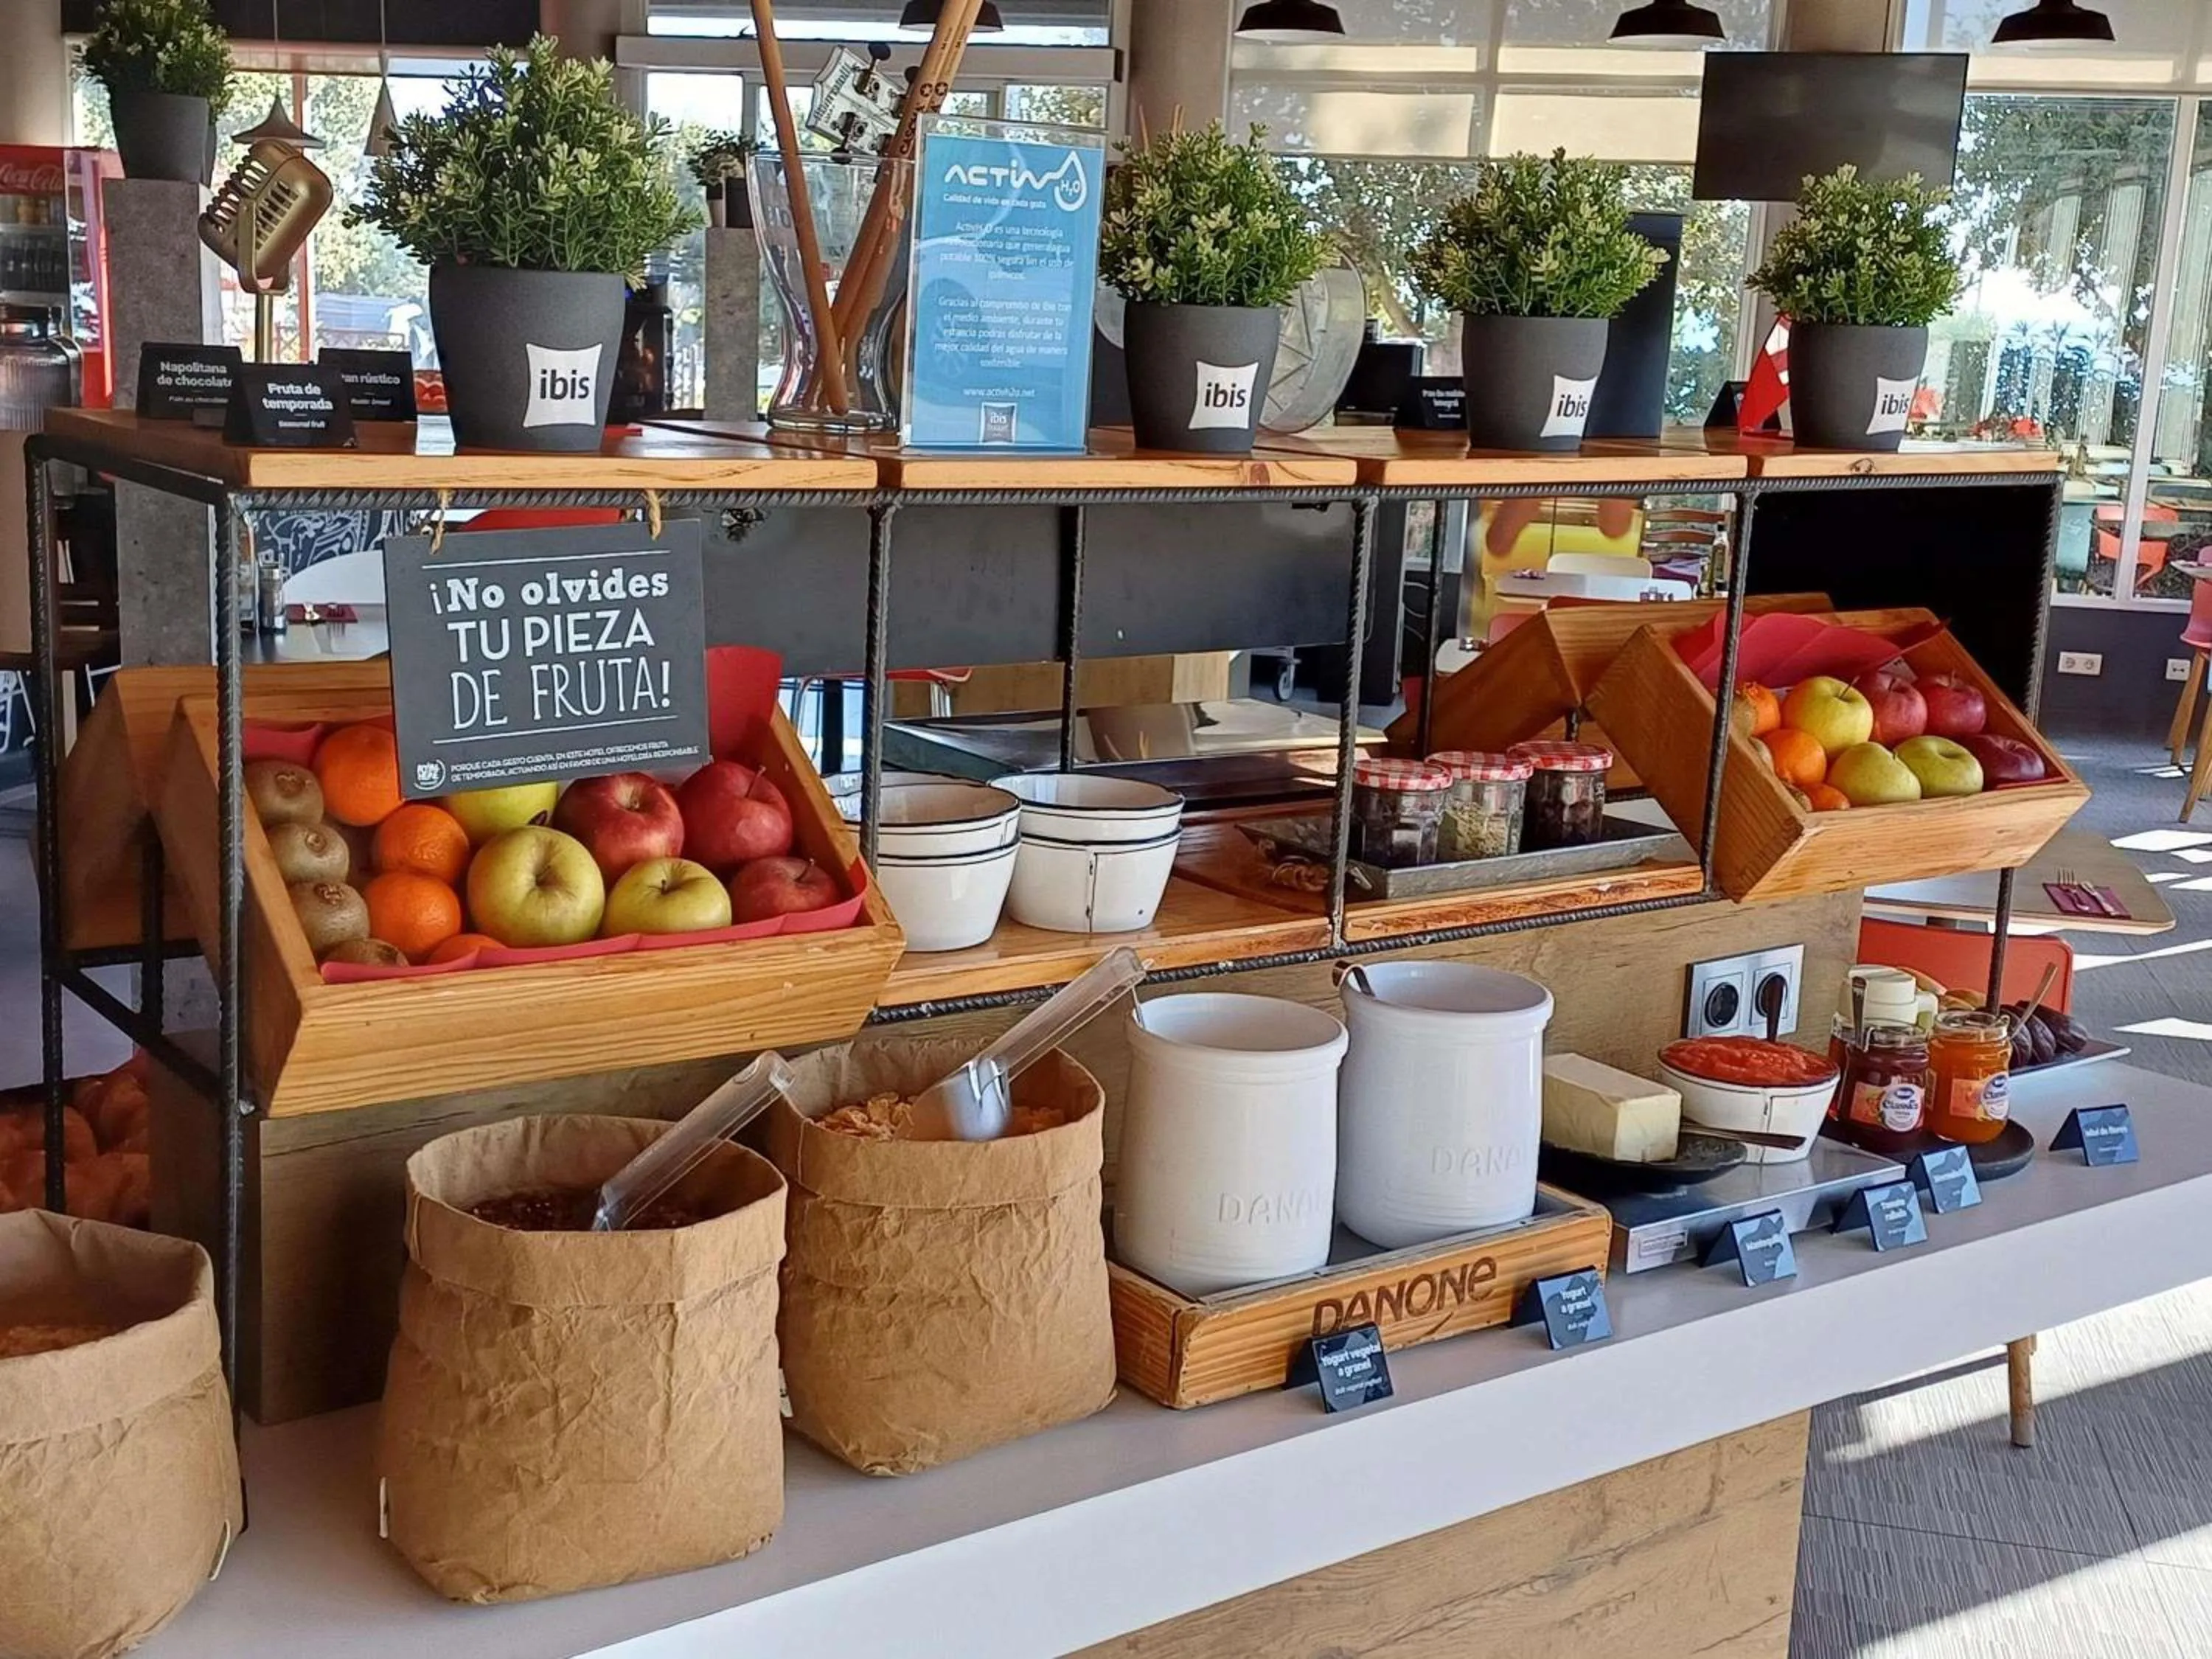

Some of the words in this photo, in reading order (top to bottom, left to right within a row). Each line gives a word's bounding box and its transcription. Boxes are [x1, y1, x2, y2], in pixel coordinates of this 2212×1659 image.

[160, 361, 227, 375] Napolitana
[341, 374, 359, 383] an
[360, 372, 400, 384] rústico
[157, 374, 173, 385] de
[267, 383, 304, 394] Fruta
[305, 382, 321, 395] de
[539, 369, 590, 400] ibis
[262, 397, 333, 412] temporada
[1204, 382, 1246, 408] ibis
[1557, 394, 1587, 417] ibis
[1881, 393, 1910, 415] ibis
[430, 577, 505, 615] ¡No
[521, 567, 669, 607] olvides
[447, 618, 509, 664] TU
[524, 608, 655, 658] PIEZA
[451, 669, 508, 730] DE
[530, 656, 671, 721] FRUTA!
[451, 762, 481, 773] PORQUE
[481, 759, 501, 770] CADA
[502, 757, 526, 767] GESTO
[507, 764, 546, 776] ACTUANDO
[1312, 1256, 1497, 1336] DANONE
[1562, 1286, 1587, 1301] Yogurt
[1321, 1350, 1349, 1366] Yogurt
[1349, 1341, 1382, 1358] vegetal
[1338, 1368, 1344, 1377] a
[1344, 1357, 1372, 1377] granel
